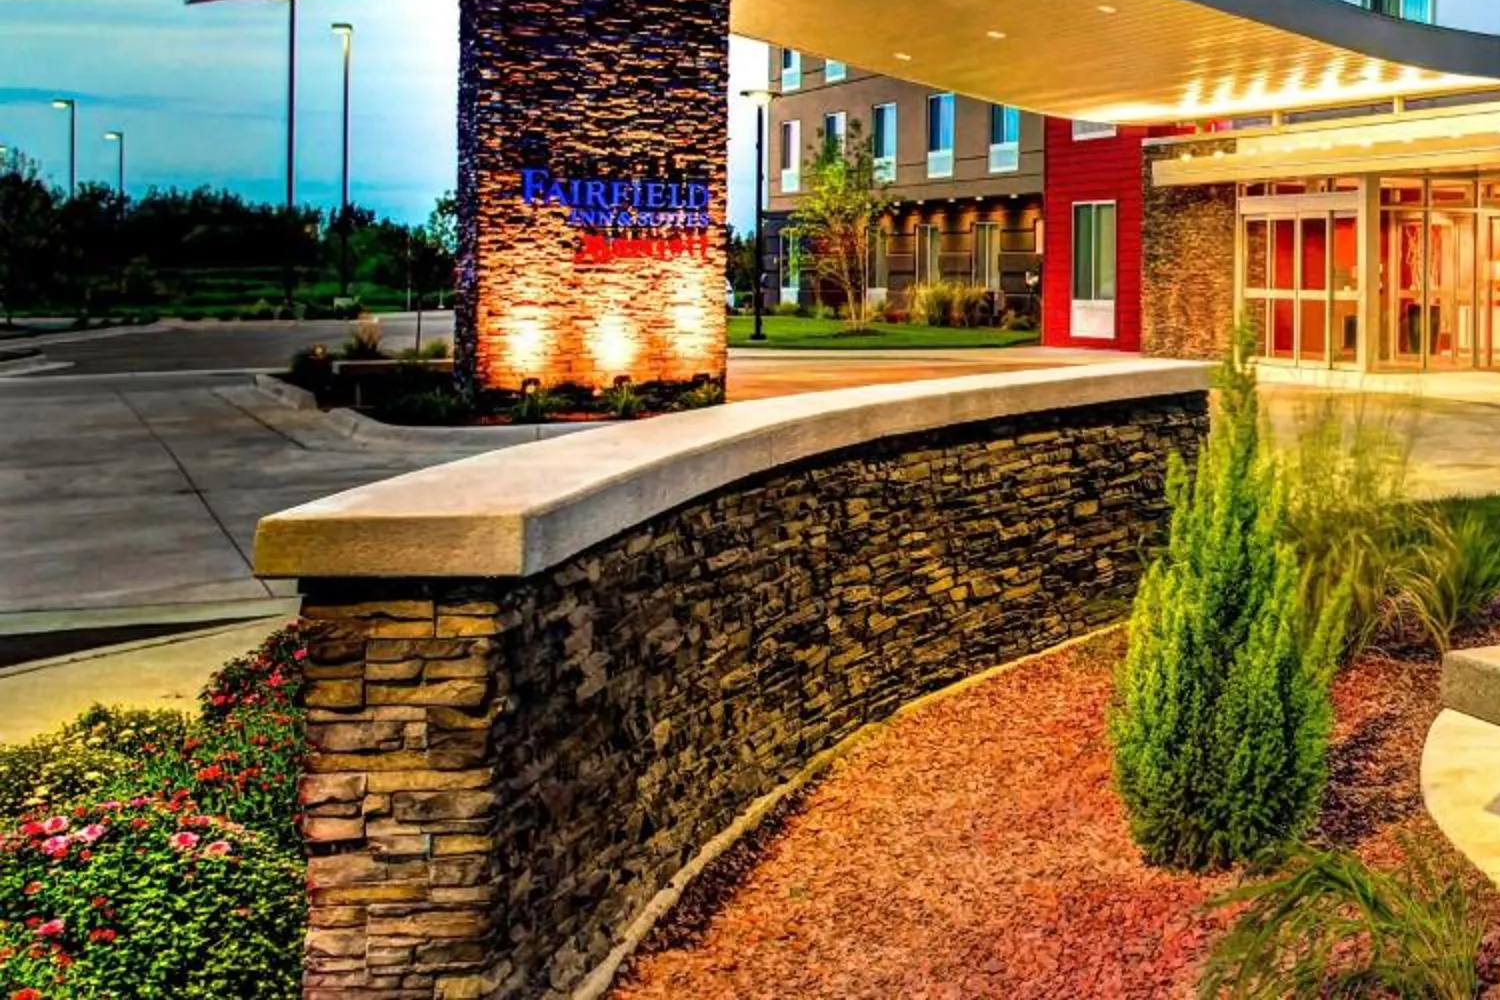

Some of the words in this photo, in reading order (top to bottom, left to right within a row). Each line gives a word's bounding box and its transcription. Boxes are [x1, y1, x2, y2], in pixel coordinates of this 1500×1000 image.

[521, 168, 709, 209] FAIRFIELD
[569, 208, 612, 226] INN
[638, 211, 710, 227] SUITES
